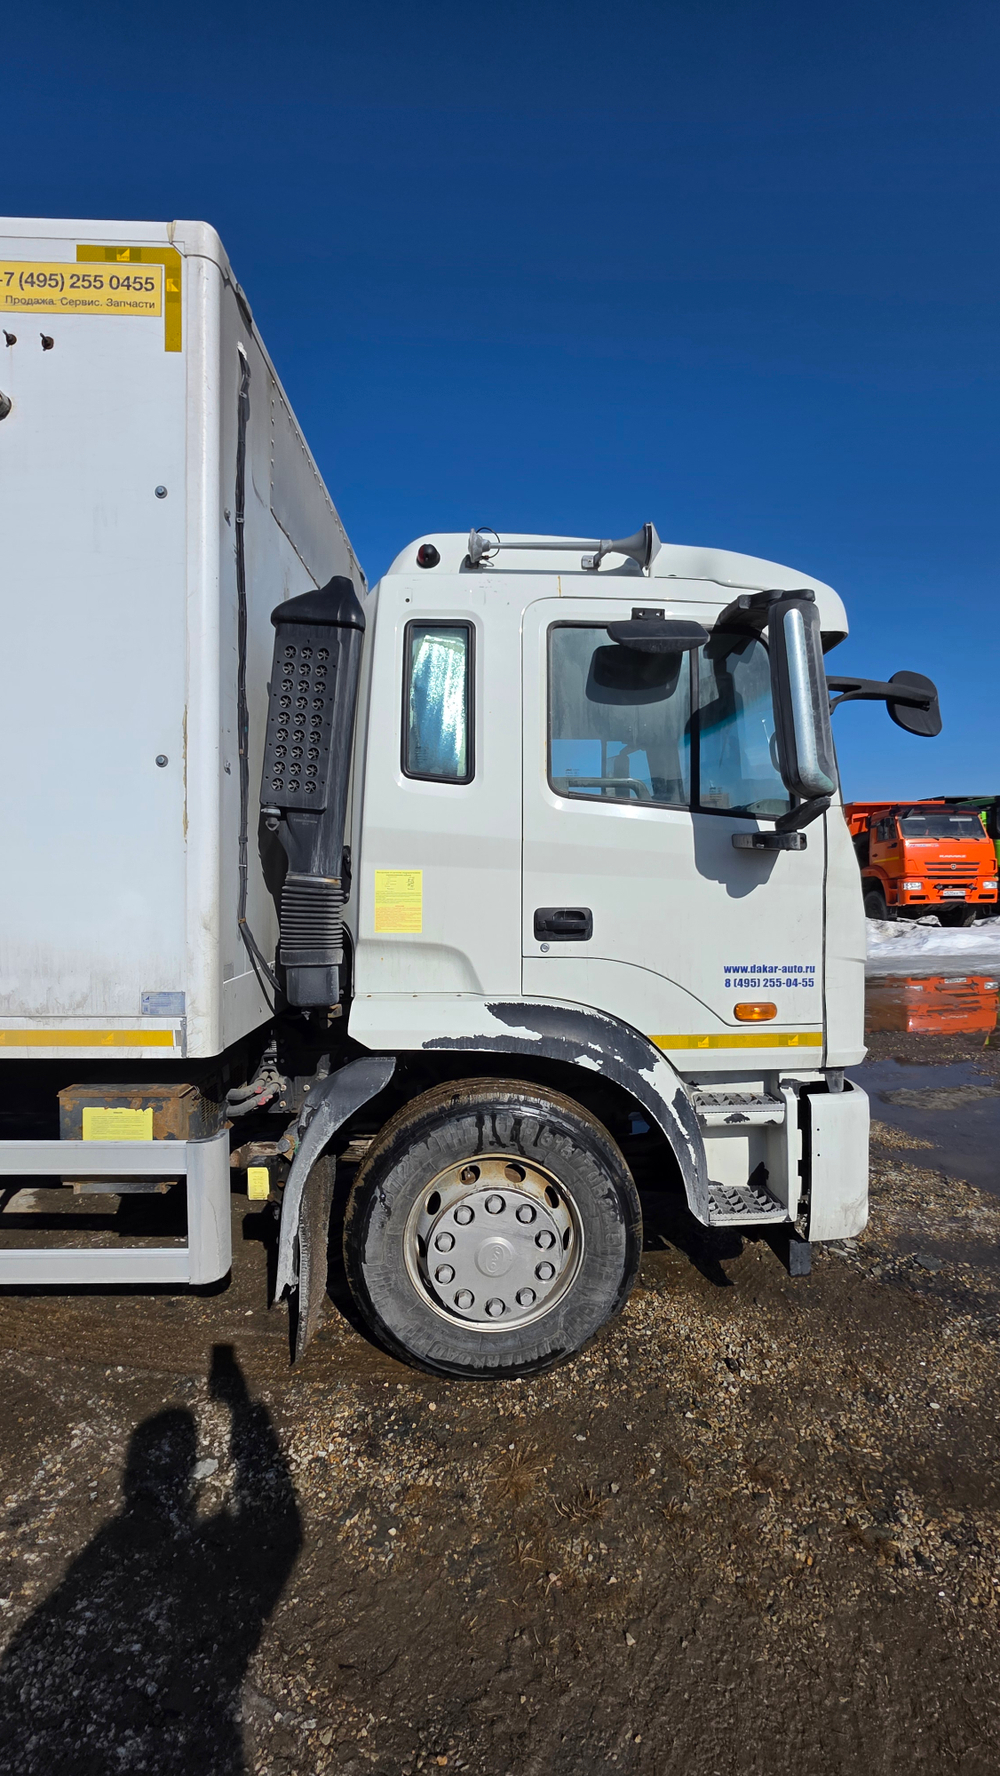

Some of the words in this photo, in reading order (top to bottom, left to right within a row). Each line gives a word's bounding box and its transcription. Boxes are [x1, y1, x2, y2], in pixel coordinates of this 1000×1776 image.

[19, 271, 65, 292] (495)
[69, 273, 104, 290] 255
[109, 275, 155, 292] 0455
[5, 295, 57, 306] Продажа.
[60, 296, 102, 308] Сервис.
[106, 297, 155, 309] Запчасти
[723, 964, 815, 973] www.dakar-auto.ru
[724, 978, 731, 987] 8
[733, 978, 760, 987] (495)
[763, 978, 814, 987] 255-04-55
